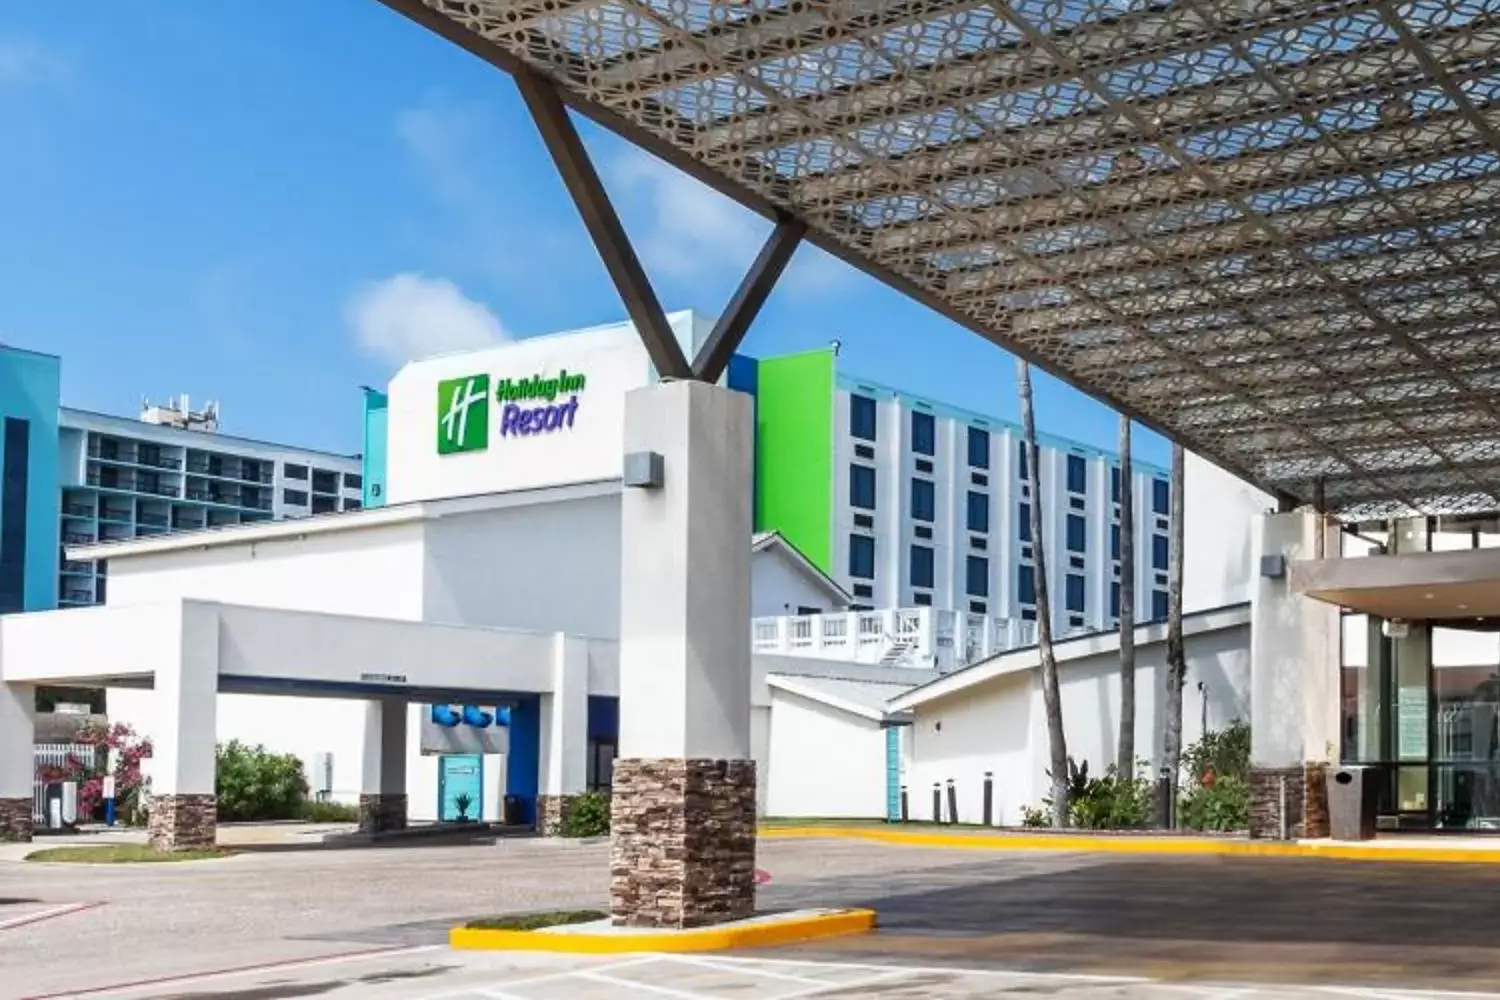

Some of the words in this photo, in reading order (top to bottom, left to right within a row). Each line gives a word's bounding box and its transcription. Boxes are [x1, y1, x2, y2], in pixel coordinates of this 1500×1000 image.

[496, 374, 559, 402] Holiday
[559, 369, 585, 393] Inn
[500, 396, 578, 437] Resort
